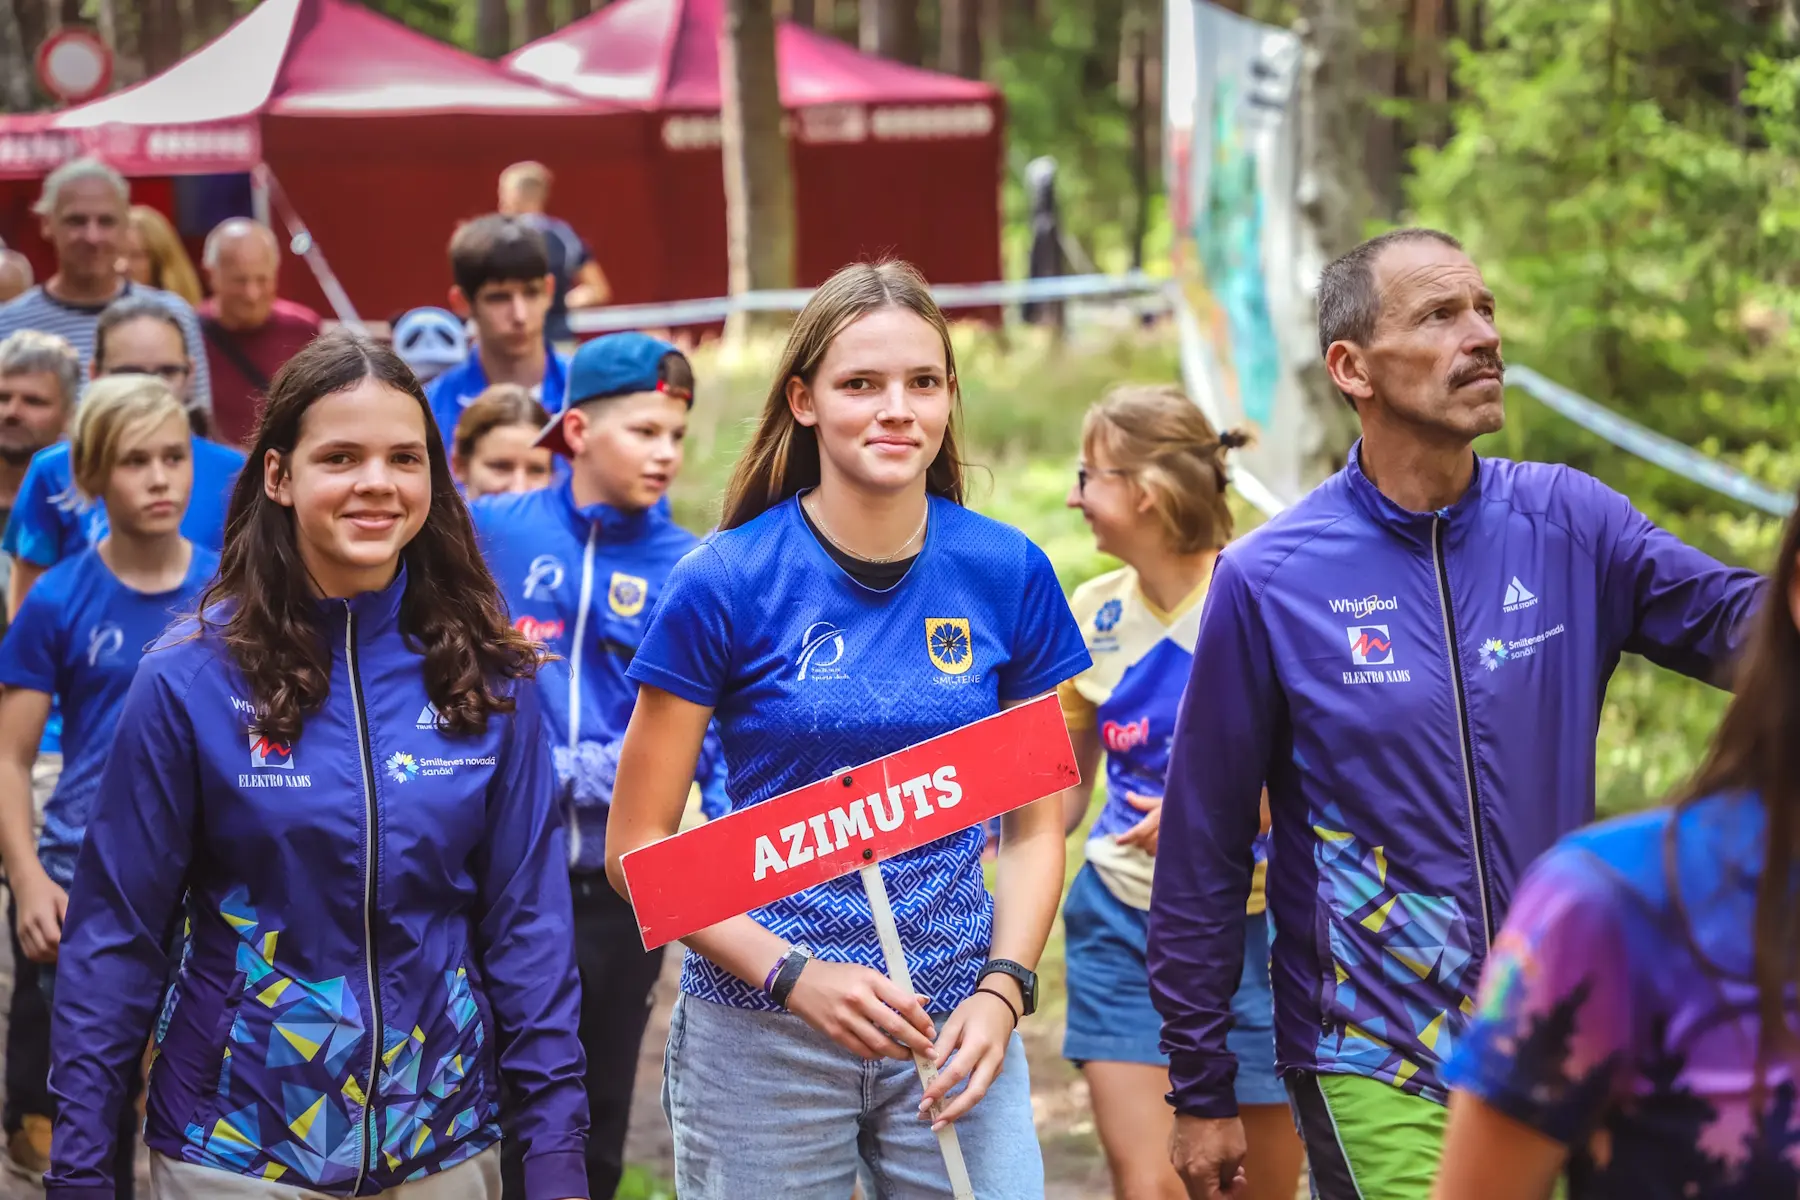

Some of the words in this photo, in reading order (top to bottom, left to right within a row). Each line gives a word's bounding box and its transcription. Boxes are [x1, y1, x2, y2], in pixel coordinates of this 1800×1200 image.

[1328, 594, 1398, 619] Whirlpool
[1503, 603, 1519, 613] TRUE
[1519, 597, 1538, 609] STORY
[1508, 633, 1545, 650] Smiltenes
[932, 674, 981, 685] SMILTENE
[1342, 669, 1385, 685] ELEKTRO
[1386, 669, 1411, 683] NAMS
[419, 757, 464, 767] Smiltenes
[465, 756, 496, 766] novadā
[422, 767, 454, 776] sanāk!
[238, 774, 283, 788] ELEKTRO
[285, 775, 312, 788] NAMS
[752, 765, 963, 882] AZIMUTS
